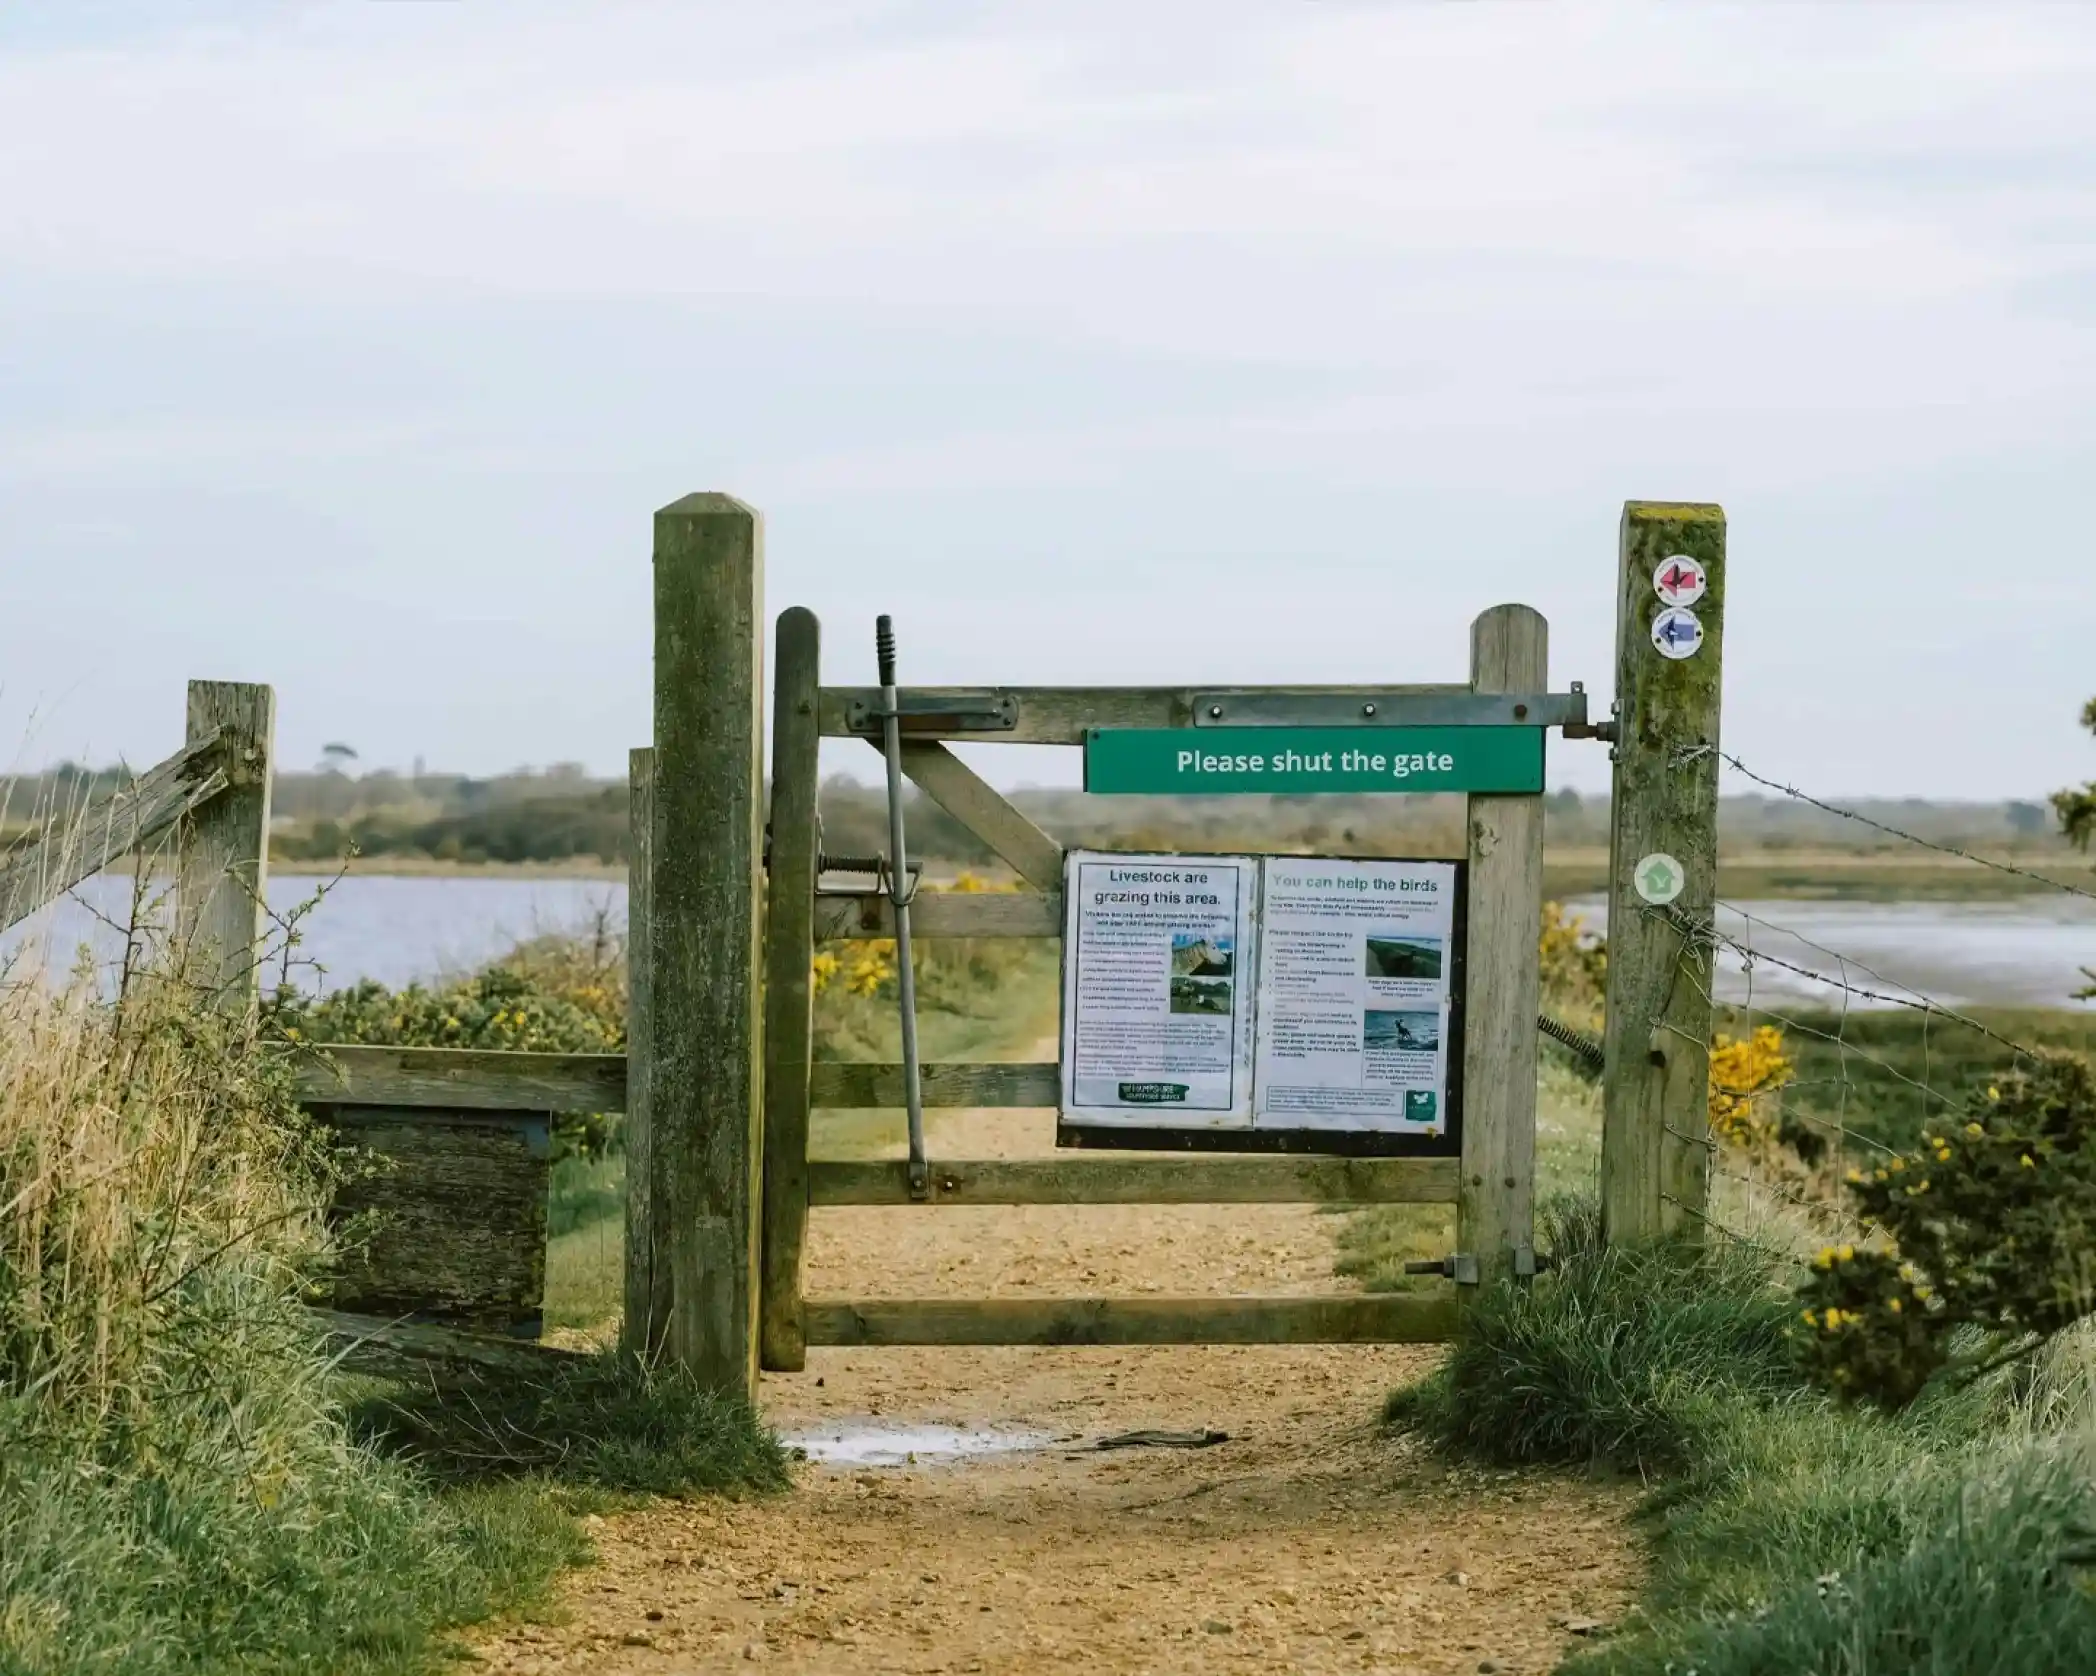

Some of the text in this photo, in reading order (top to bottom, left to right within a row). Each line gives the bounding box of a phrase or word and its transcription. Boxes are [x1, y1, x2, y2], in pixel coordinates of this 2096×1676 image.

[1176, 749, 1454, 777] Please shut the gate
[1109, 869, 1208, 884] Livestock are
[1272, 874, 1438, 892] You can help the birds
[1094, 890, 1221, 906] grazing this area.
